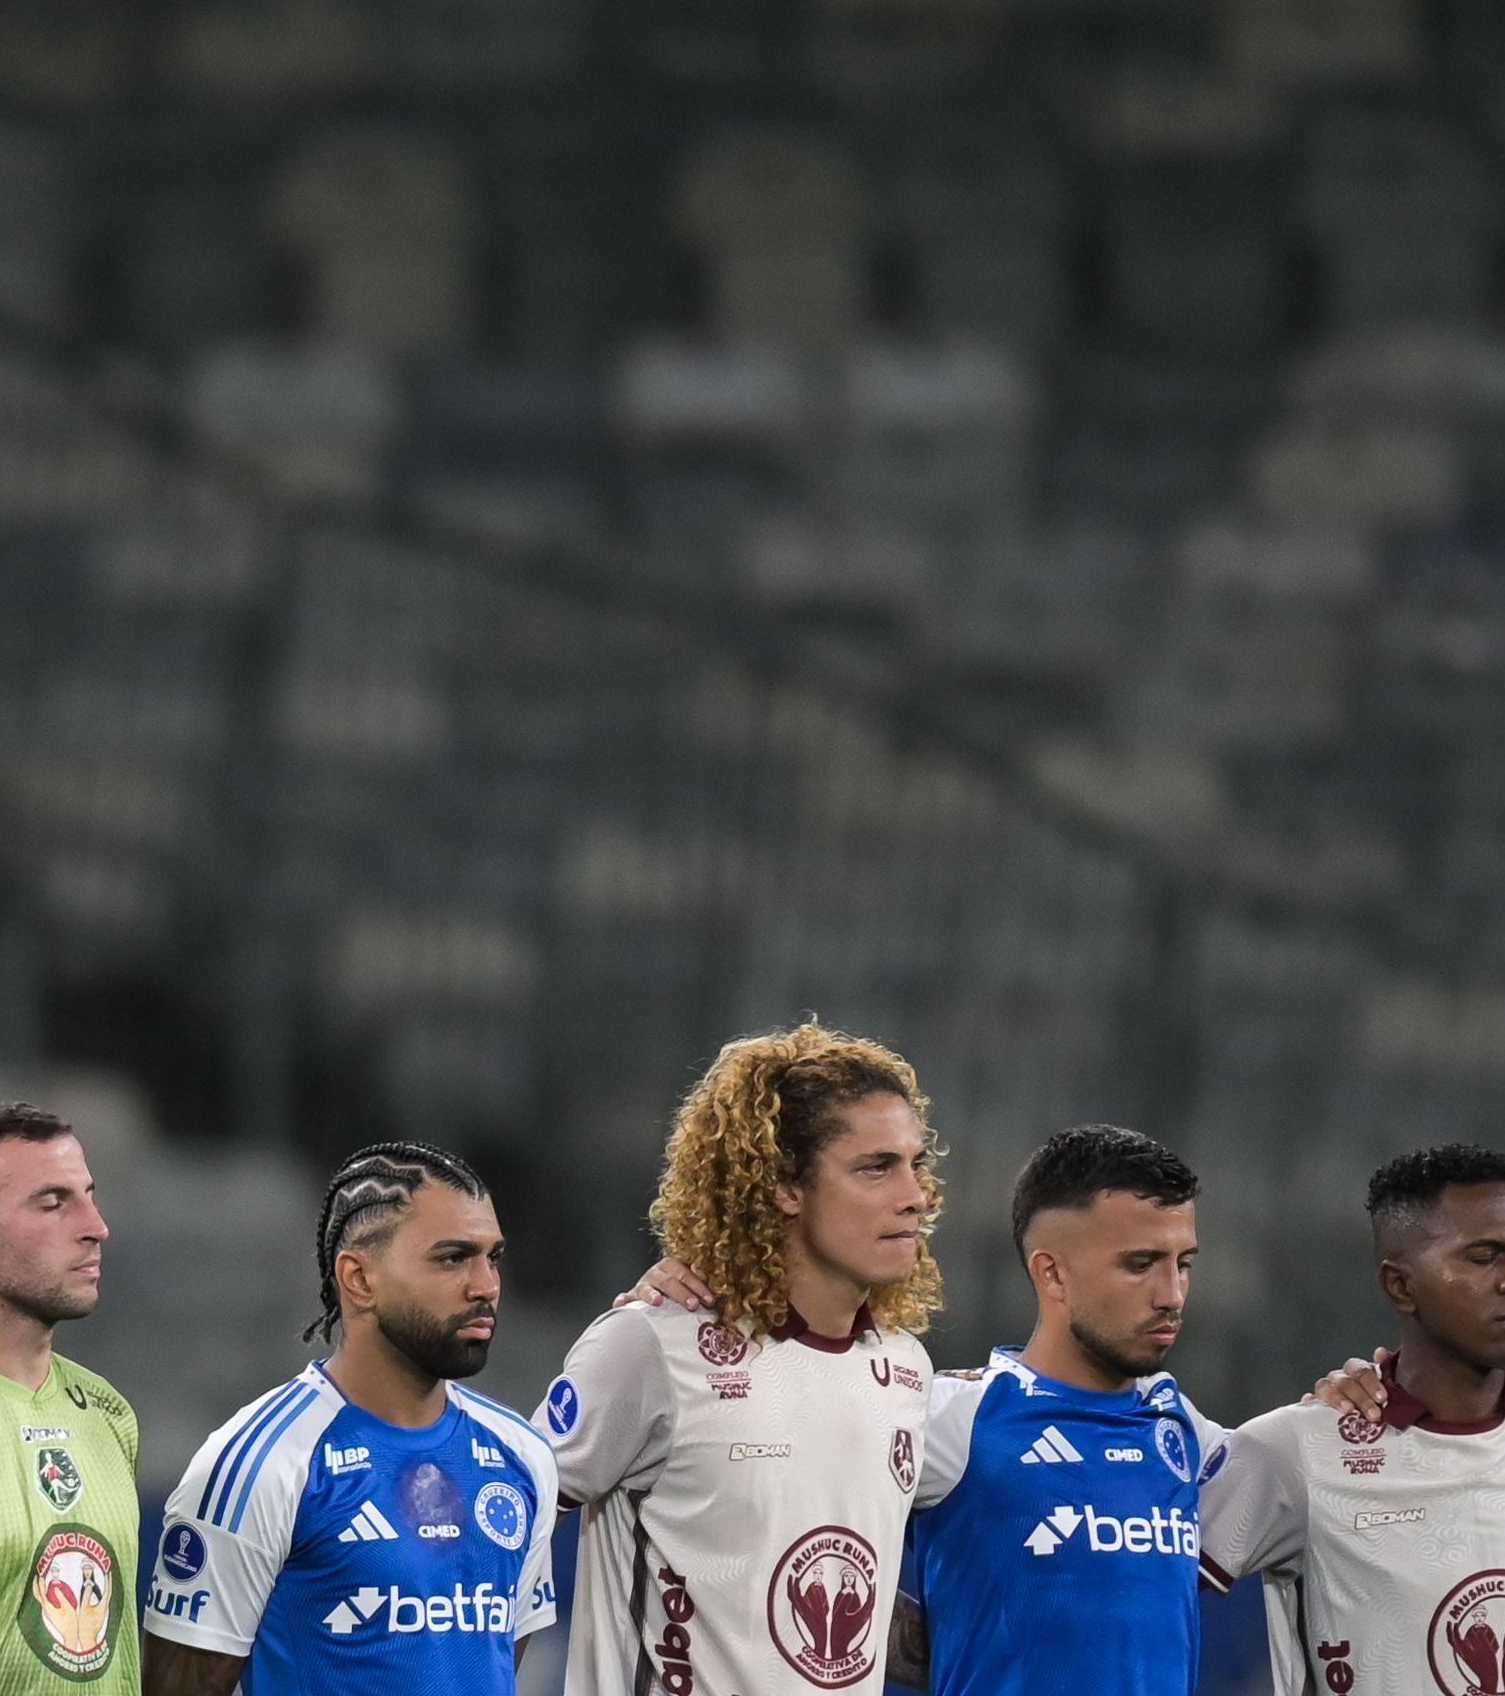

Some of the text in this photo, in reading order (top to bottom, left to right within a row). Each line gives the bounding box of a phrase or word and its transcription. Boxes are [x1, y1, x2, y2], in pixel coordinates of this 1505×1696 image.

[718, 1390, 749, 1400] RUNA
[1104, 1448, 1144, 1462] CIMED
[1350, 1466, 1380, 1475] RUNA
[479, 1485, 521, 1513] CRUZEIRO
[418, 1523, 460, 1539] CIMED
[479, 1508, 513, 1547] ESPORTE
[1083, 1503, 1199, 1558] betfai
[77, 1533, 113, 1570] RUNA
[791, 1538, 876, 1581] MUSHUC RUNA
[1449, 1580, 1505, 1620] MUSHUC
